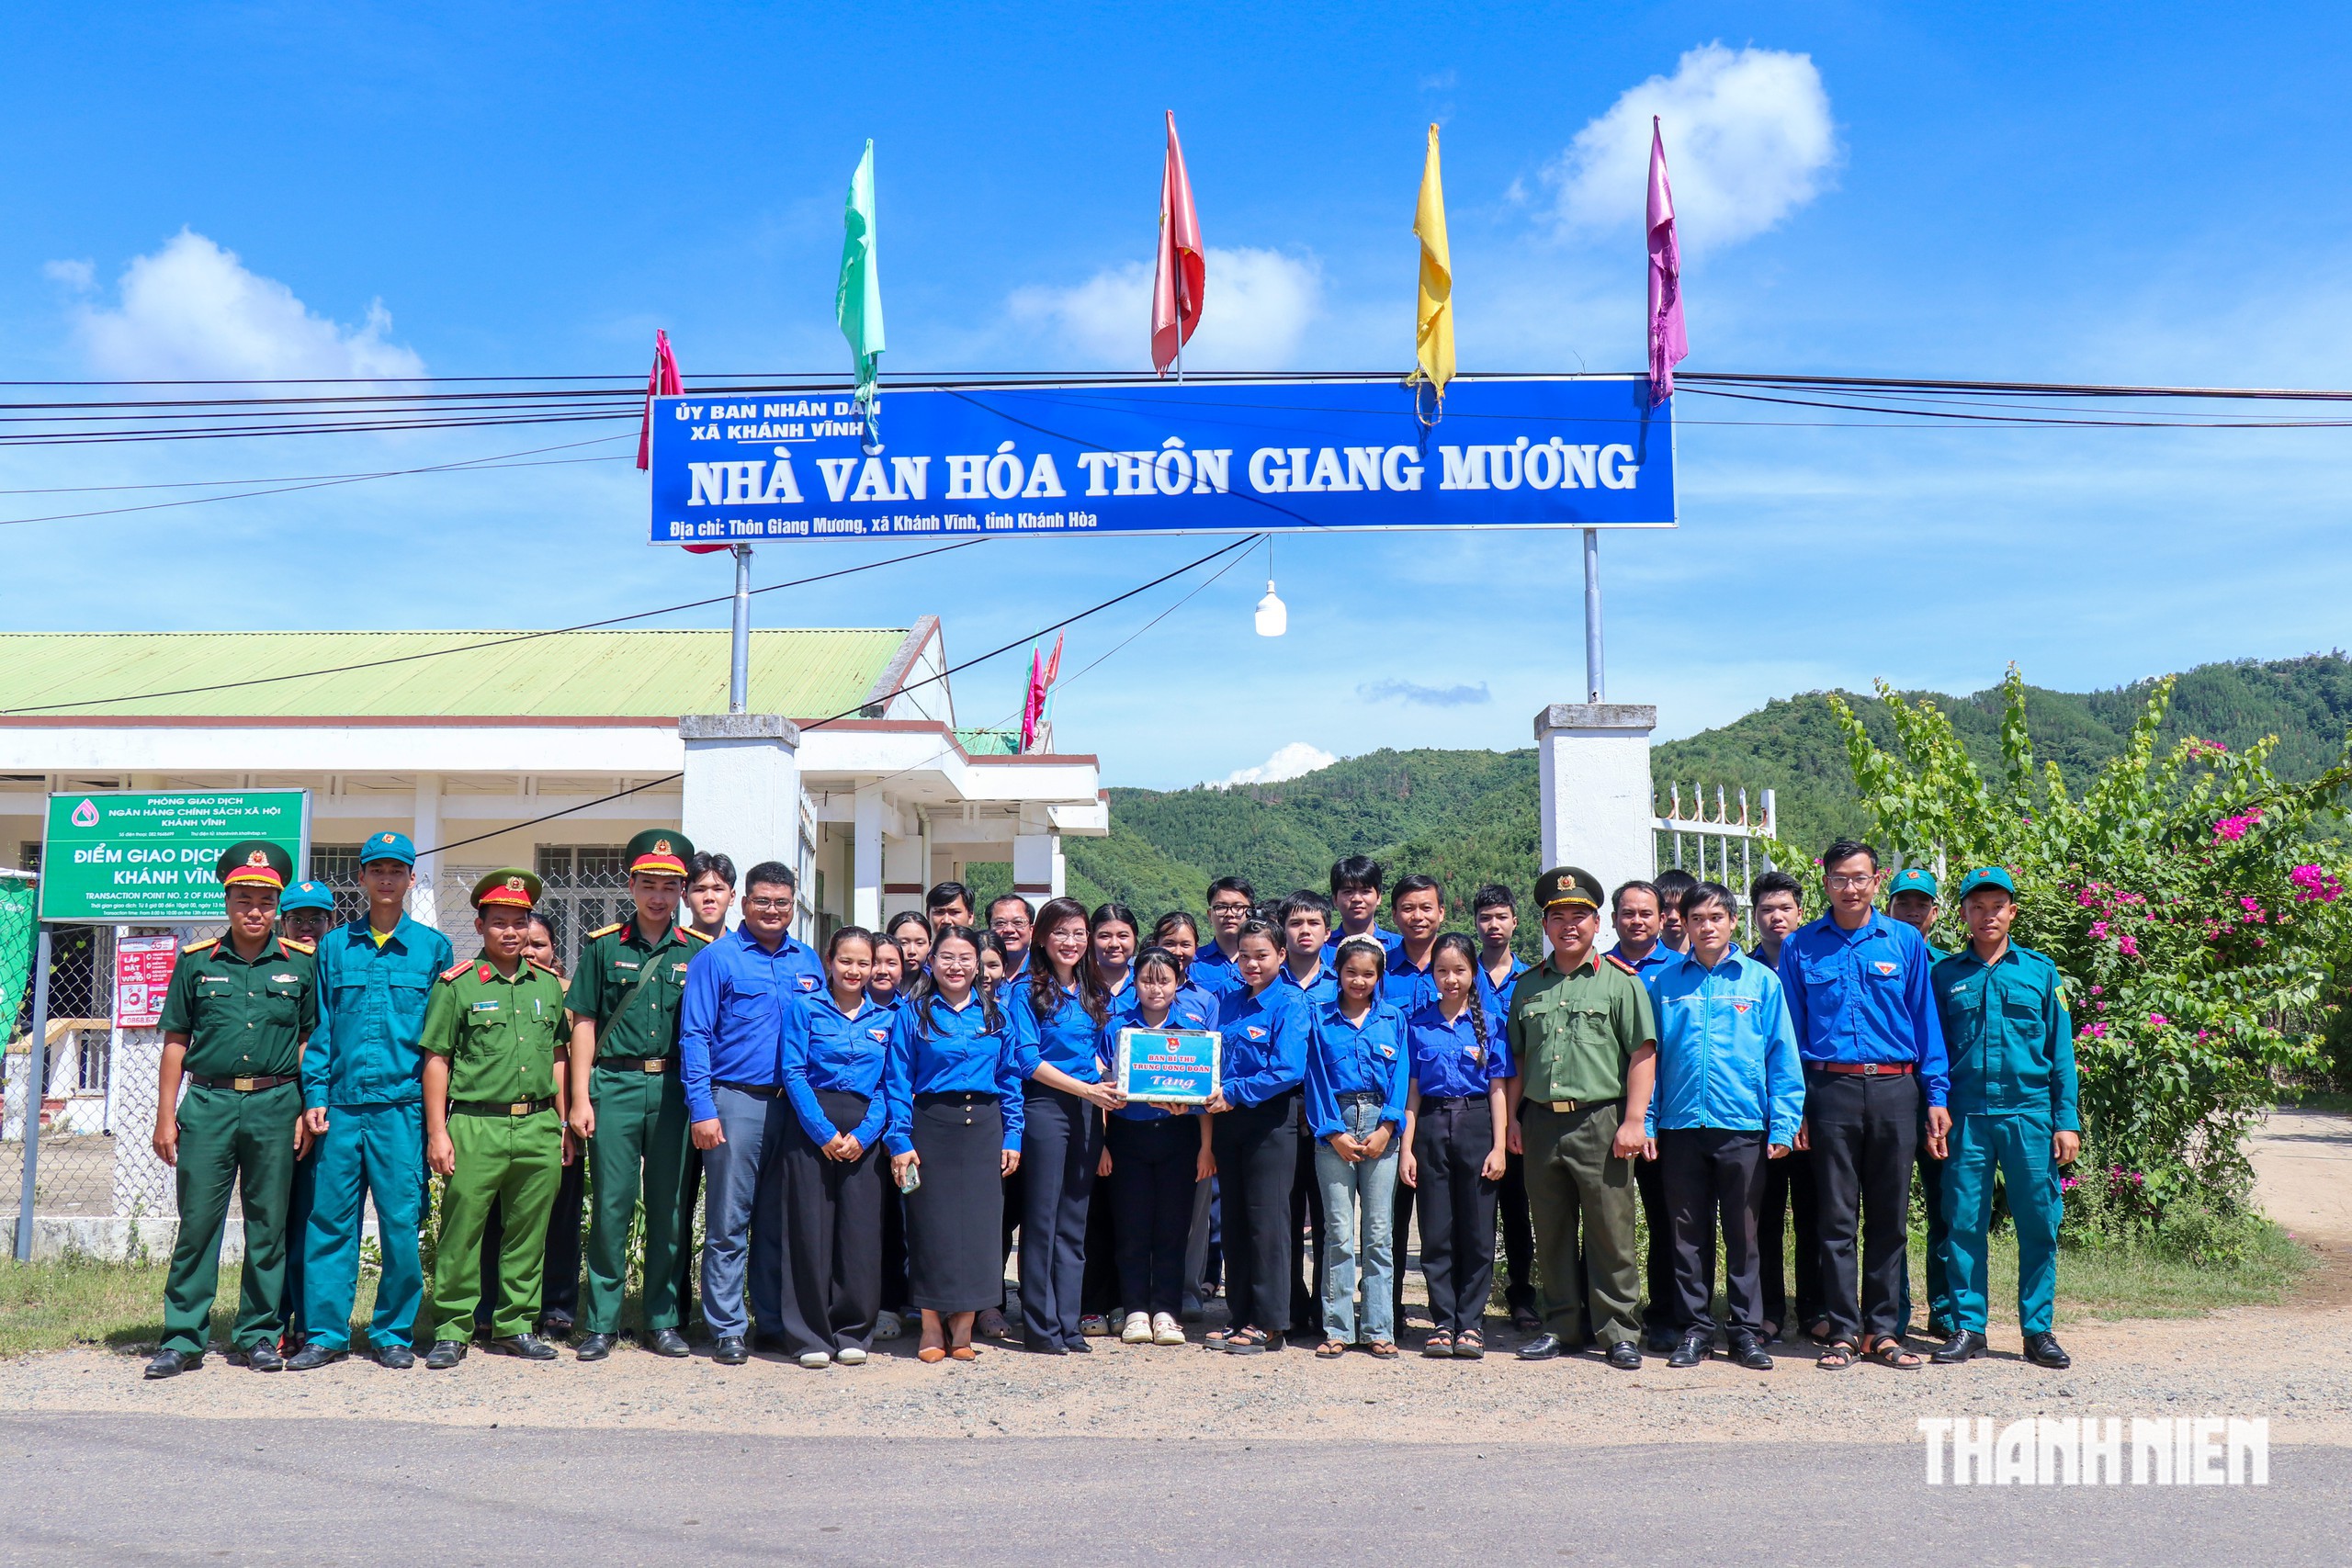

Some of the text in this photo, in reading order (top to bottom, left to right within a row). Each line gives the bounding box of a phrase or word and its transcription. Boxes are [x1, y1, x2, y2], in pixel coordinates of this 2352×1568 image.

[675, 401, 704, 421] ỦY
[710, 403, 757, 420] BAN
[763, 400, 827, 418] NHÂN
[690, 419, 864, 440] XÃ KHÁNH VĨNH
[686, 435, 1640, 507] NHÀ VĂN HÓA THÔN GIANG MƯƠNG
[670, 511, 1097, 540] Địa chỉ: Thôn Giang Mương, xã Khánh Vĩnh, tỉnh Khánh Hòa
[147, 797, 185, 806] PHÒNG
[217, 797, 243, 806] DỊCH
[108, 808, 140, 817] NGÂN
[143, 808, 175, 816] HÀNG
[177, 807, 210, 816] CHÍNH
[212, 807, 242, 815] SÁCH
[263, 807, 281, 816] HỘI
[161, 818, 226, 826] KHÁNH VĨNH
[74, 843, 122, 863] ĐIỂM
[127, 848, 176, 863] GIAO
[113, 867, 220, 884] KHÁNH VĨN
